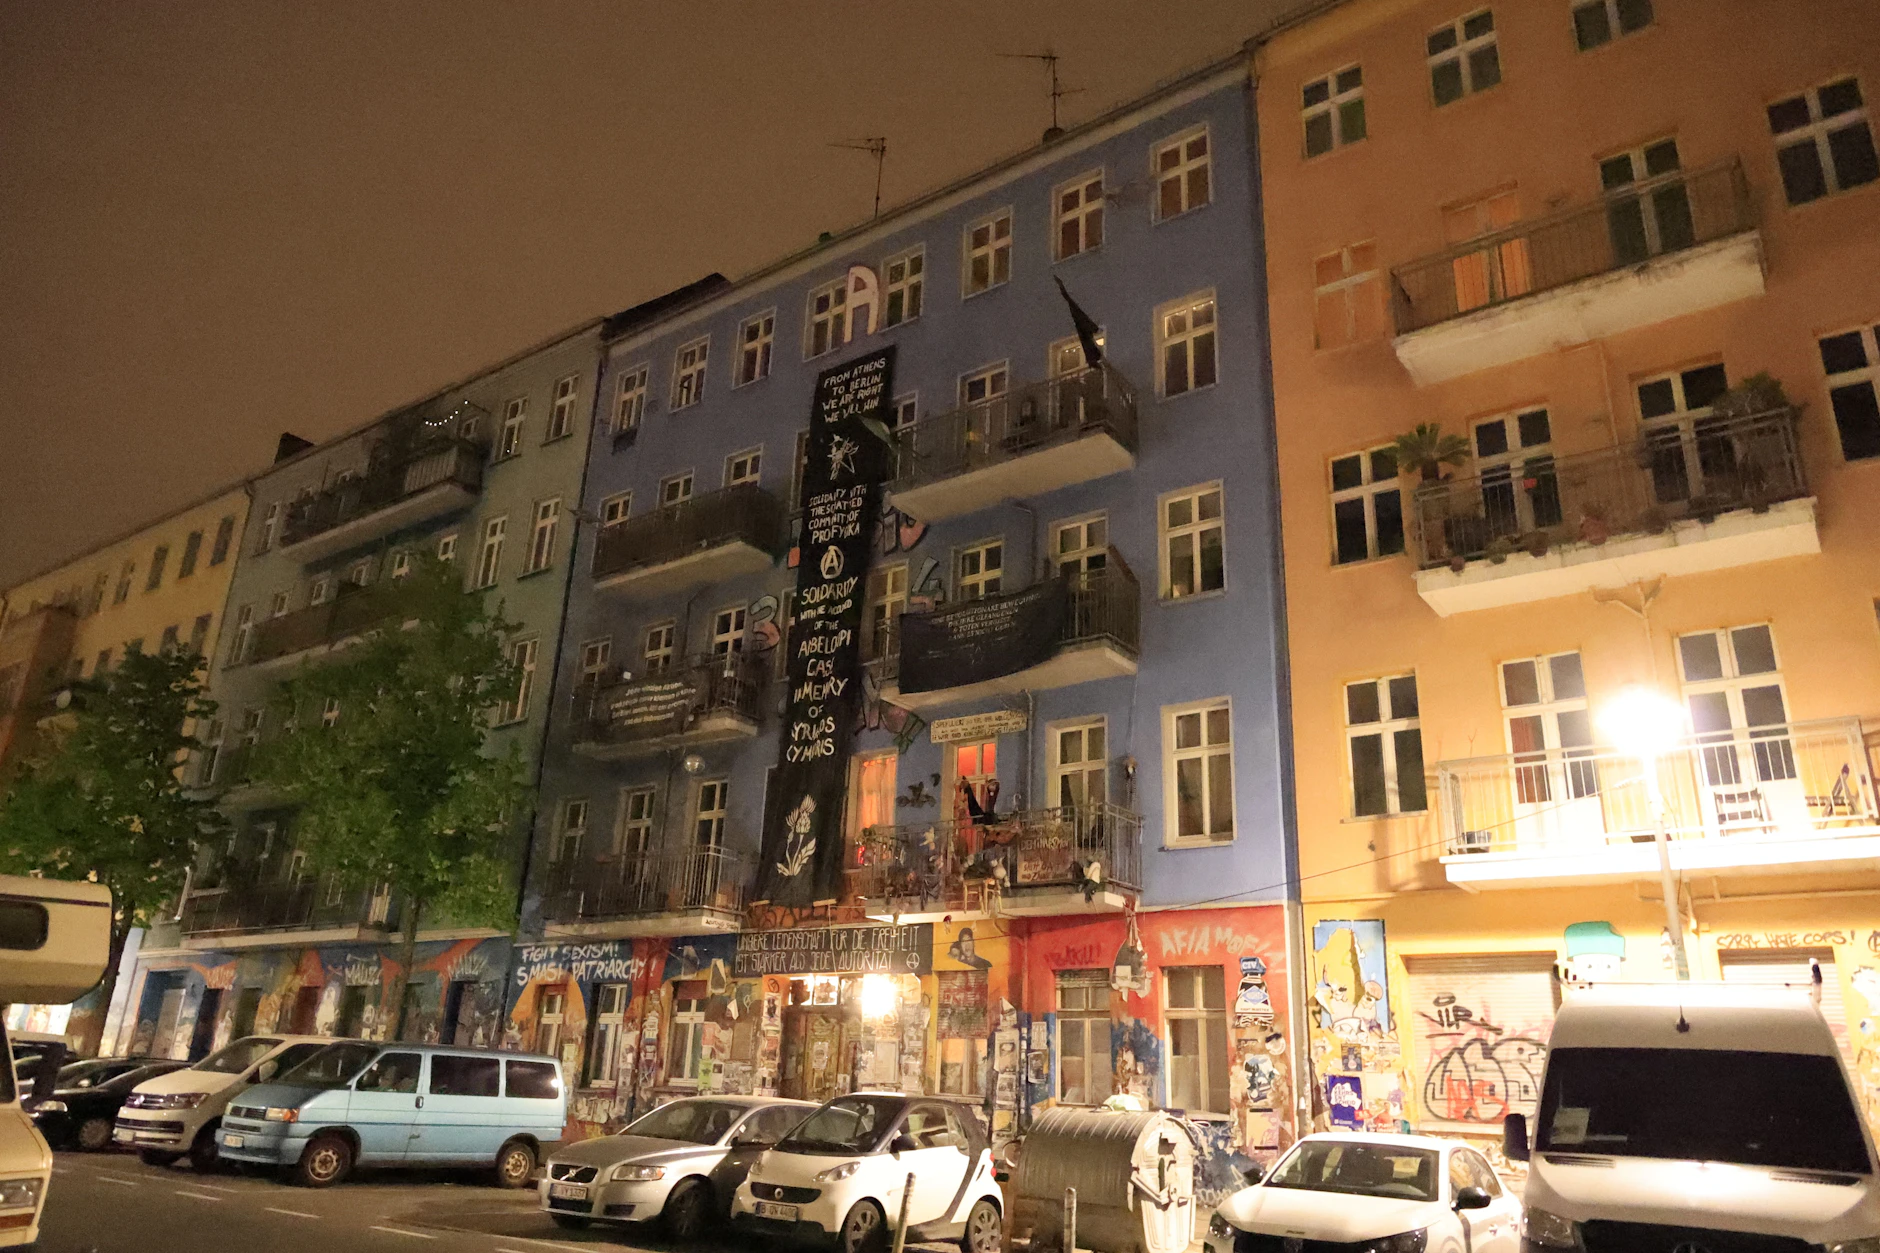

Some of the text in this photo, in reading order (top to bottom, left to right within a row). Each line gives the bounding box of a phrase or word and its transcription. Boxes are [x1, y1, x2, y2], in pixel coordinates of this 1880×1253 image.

[824, 357, 886, 388] FROM ATHENS
[832, 372, 882, 396] TO BERLIN
[822, 383, 884, 411] WE ARE RIGHT
[824, 411, 840, 423] WE
[814, 620, 840, 630] OF THE
[802, 676, 849, 702] MEMRY
[808, 704, 824, 718] OF
[736, 932, 770, 952] UNSERE
[772, 930, 827, 951] LEIDENSCHAFT
[830, 930, 848, 950] FÜR
[872, 926, 920, 951] FREIHEIT
[1764, 932, 1800, 948] HATE
[516, 962, 569, 986] SMASH
[734, 953, 748, 974] IST
[788, 951, 806, 972] ALS
